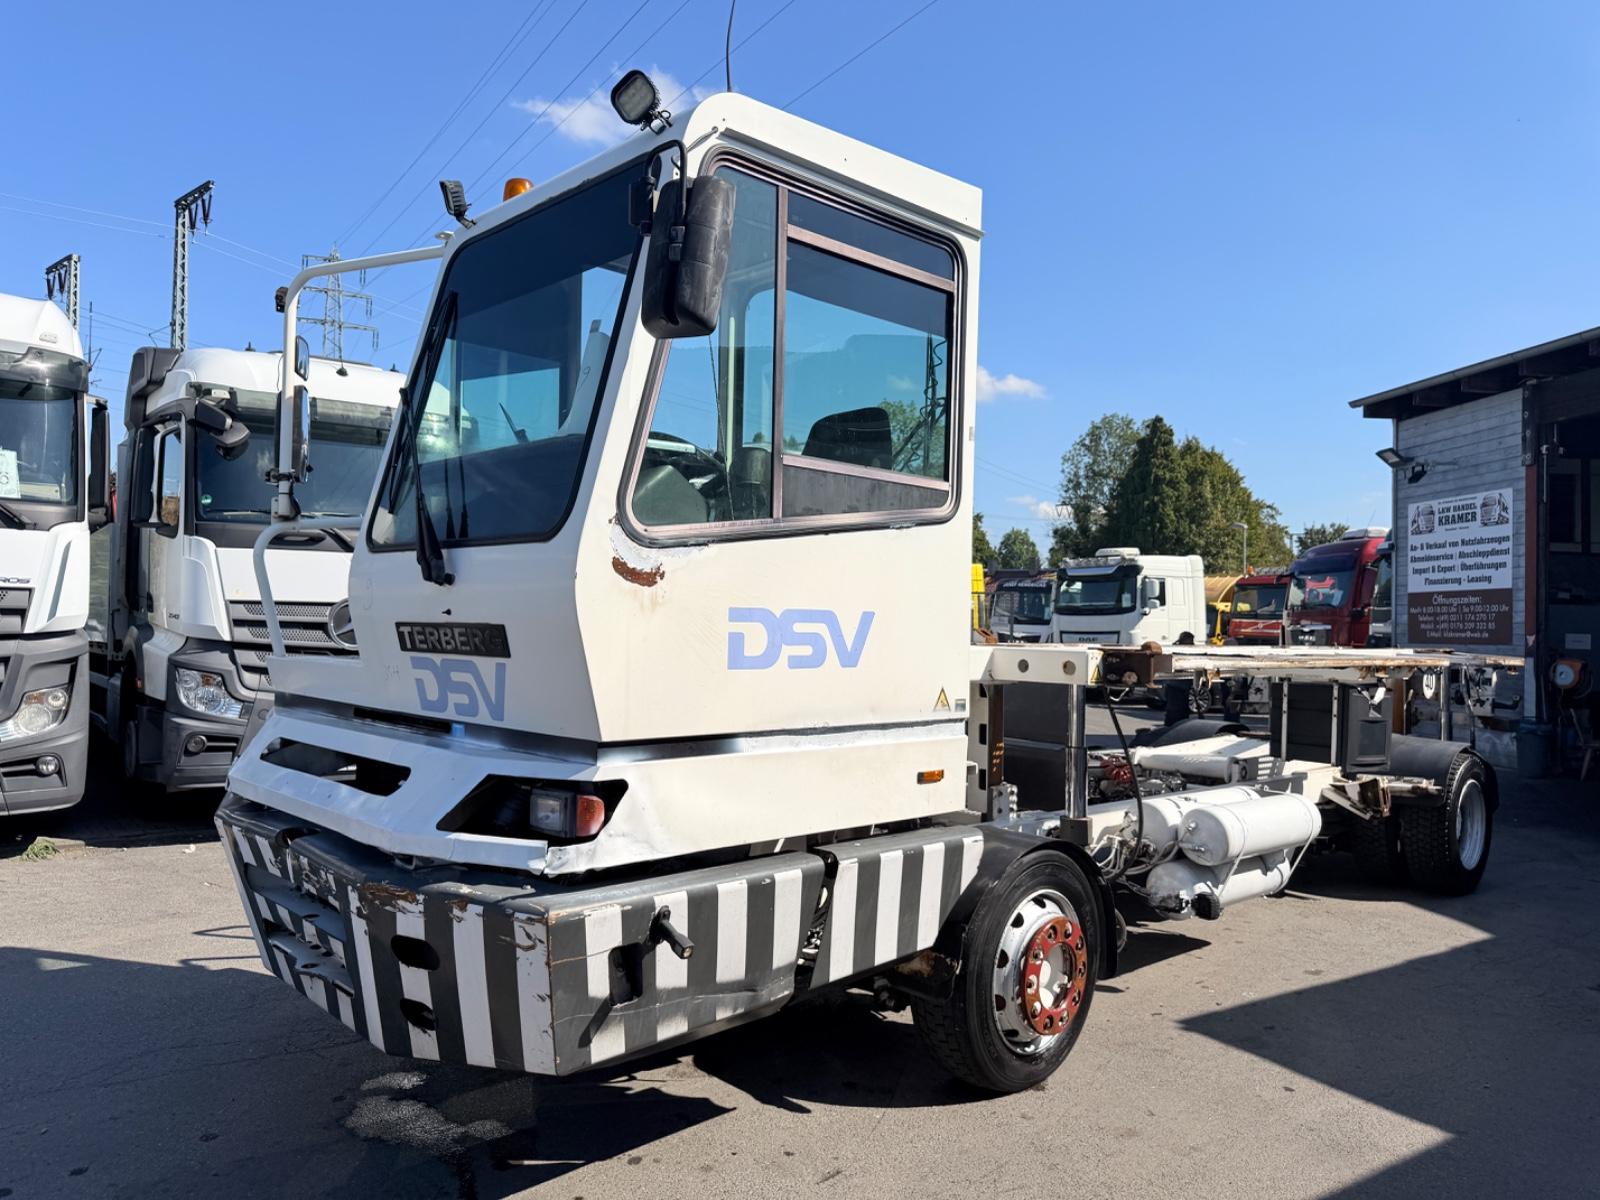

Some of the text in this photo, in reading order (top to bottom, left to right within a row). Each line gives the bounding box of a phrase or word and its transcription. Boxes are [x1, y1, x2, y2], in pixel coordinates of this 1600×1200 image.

[1438, 502, 1477, 514] LKW HANDEL
[1438, 511, 1477, 526] KRAMER
[1425, 540, 1447, 550] Verkauf
[1460, 535, 1510, 547] Nutzfahrzeugen
[1458, 547, 1510, 559] Abschleppdienst
[1412, 566, 1430, 575] Import
[1437, 564, 1455, 573] Export
[1460, 560, 1507, 571] Überführungen
[1424, 576, 1462, 586] Finanzierung
[1467, 574, 1492, 584] Leasing
[727, 606, 875, 670] DSV
[410, 656, 506, 722] DSV
